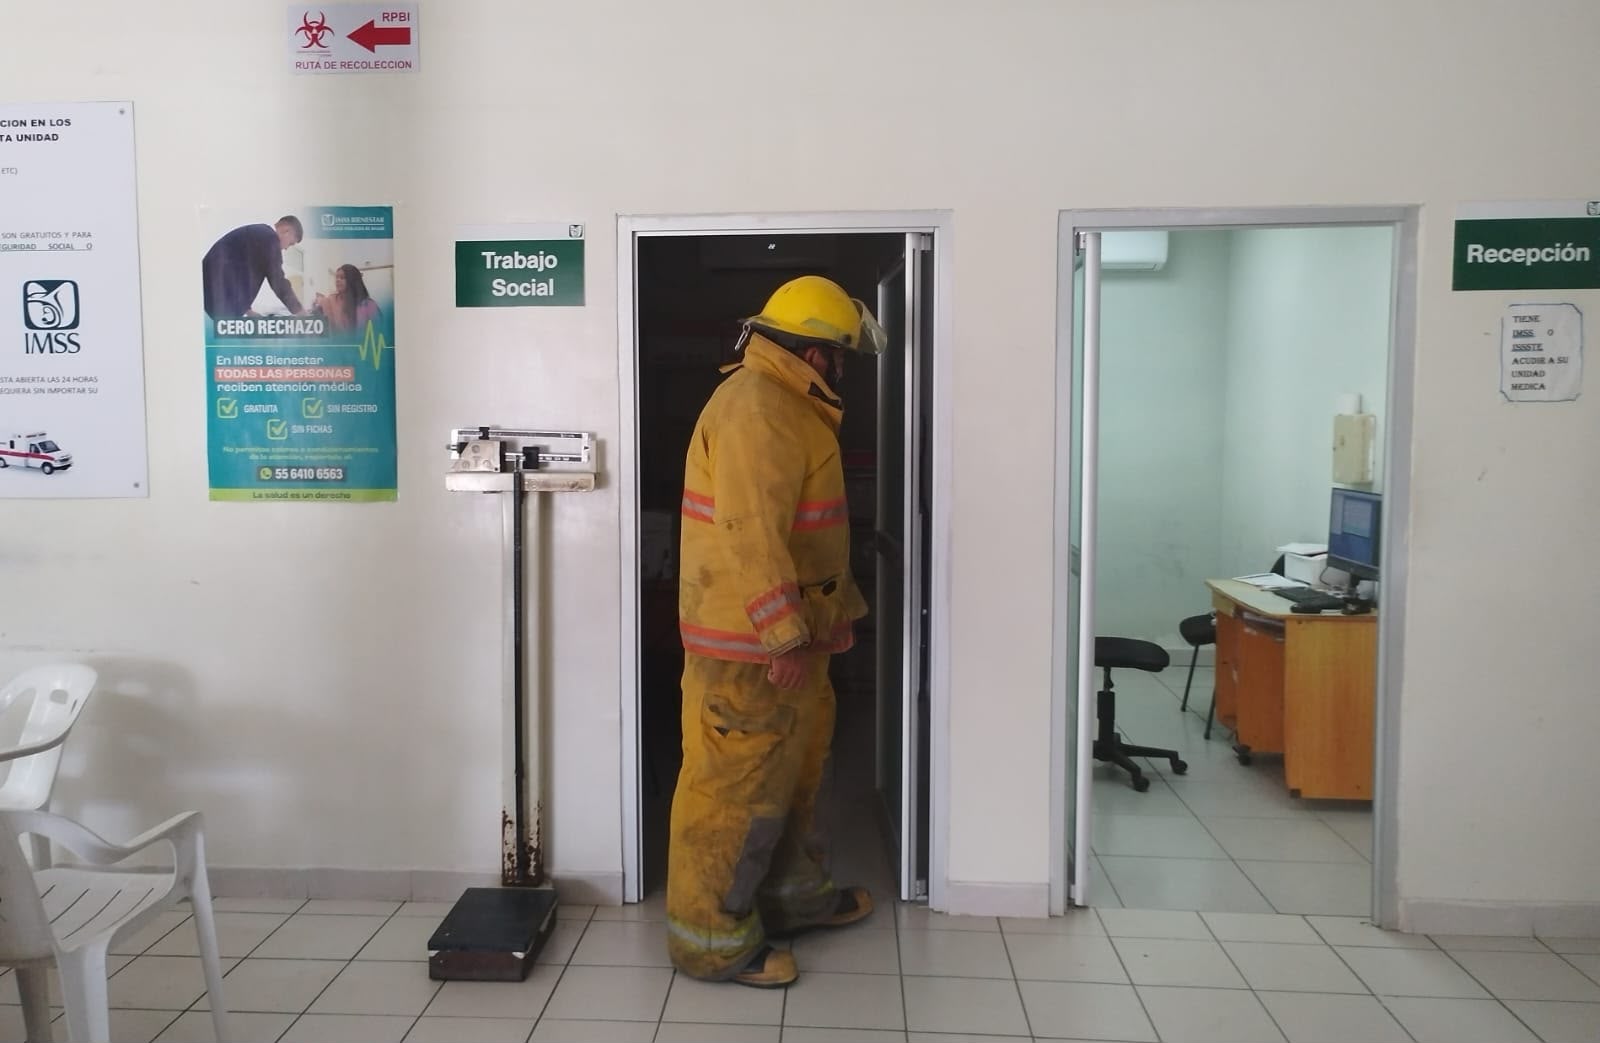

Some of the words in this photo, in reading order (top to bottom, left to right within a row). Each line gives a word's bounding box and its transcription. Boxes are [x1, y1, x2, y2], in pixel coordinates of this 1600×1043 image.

[382, 12, 410, 22] RPBI
[295, 61, 321, 69] RUTA
[324, 61, 337, 69] DE
[340, 60, 412, 69] RECOLECCION
[0, 119, 27, 127] CION
[31, 119, 46, 127] EN
[50, 118, 71, 127] LOS
[16, 133, 59, 141] UNIDAD
[20, 231, 62, 239] GRATUITOS
[86, 242, 93, 250] O
[1467, 243, 1590, 266] Recepción
[481, 251, 558, 272] Trabajo
[492, 278, 554, 297] Social
[1512, 315, 1541, 323] TIENE
[217, 319, 254, 335] CERO
[258, 319, 324, 335] RECHAZO
[1512, 329, 1535, 338] IMSS
[25, 332, 81, 354] IMSS
[216, 355, 231, 365] En
[234, 355, 263, 365] IMSS
[266, 355, 324, 365] Bienestar
[1511, 357, 1546, 365] ACUDIR
[1557, 356, 1569, 364] SU
[216, 369, 257, 378] TODAS
[260, 369, 281, 378] LAS
[285, 369, 351, 378] PERSONAS
[1511, 370, 1546, 378] UNIDAD
[217, 382, 263, 392] reciben
[265, 382, 316, 392] atención
[319, 382, 362, 392] médica
[1511, 383, 1546, 391] MEDICA
[244, 404, 278, 413] GRATUITA
[327, 404, 341, 413] SIN
[341, 404, 378, 413] REGISTRO
[291, 425, 305, 433] SIN
[306, 424, 333, 433] FICHAS
[275, 468, 289, 479] 55
[290, 468, 315, 479] 6410
[316, 468, 343, 479] 6563
[253, 491, 263, 499] La
[265, 491, 288, 499] salud
[315, 491, 351, 499] derecho
